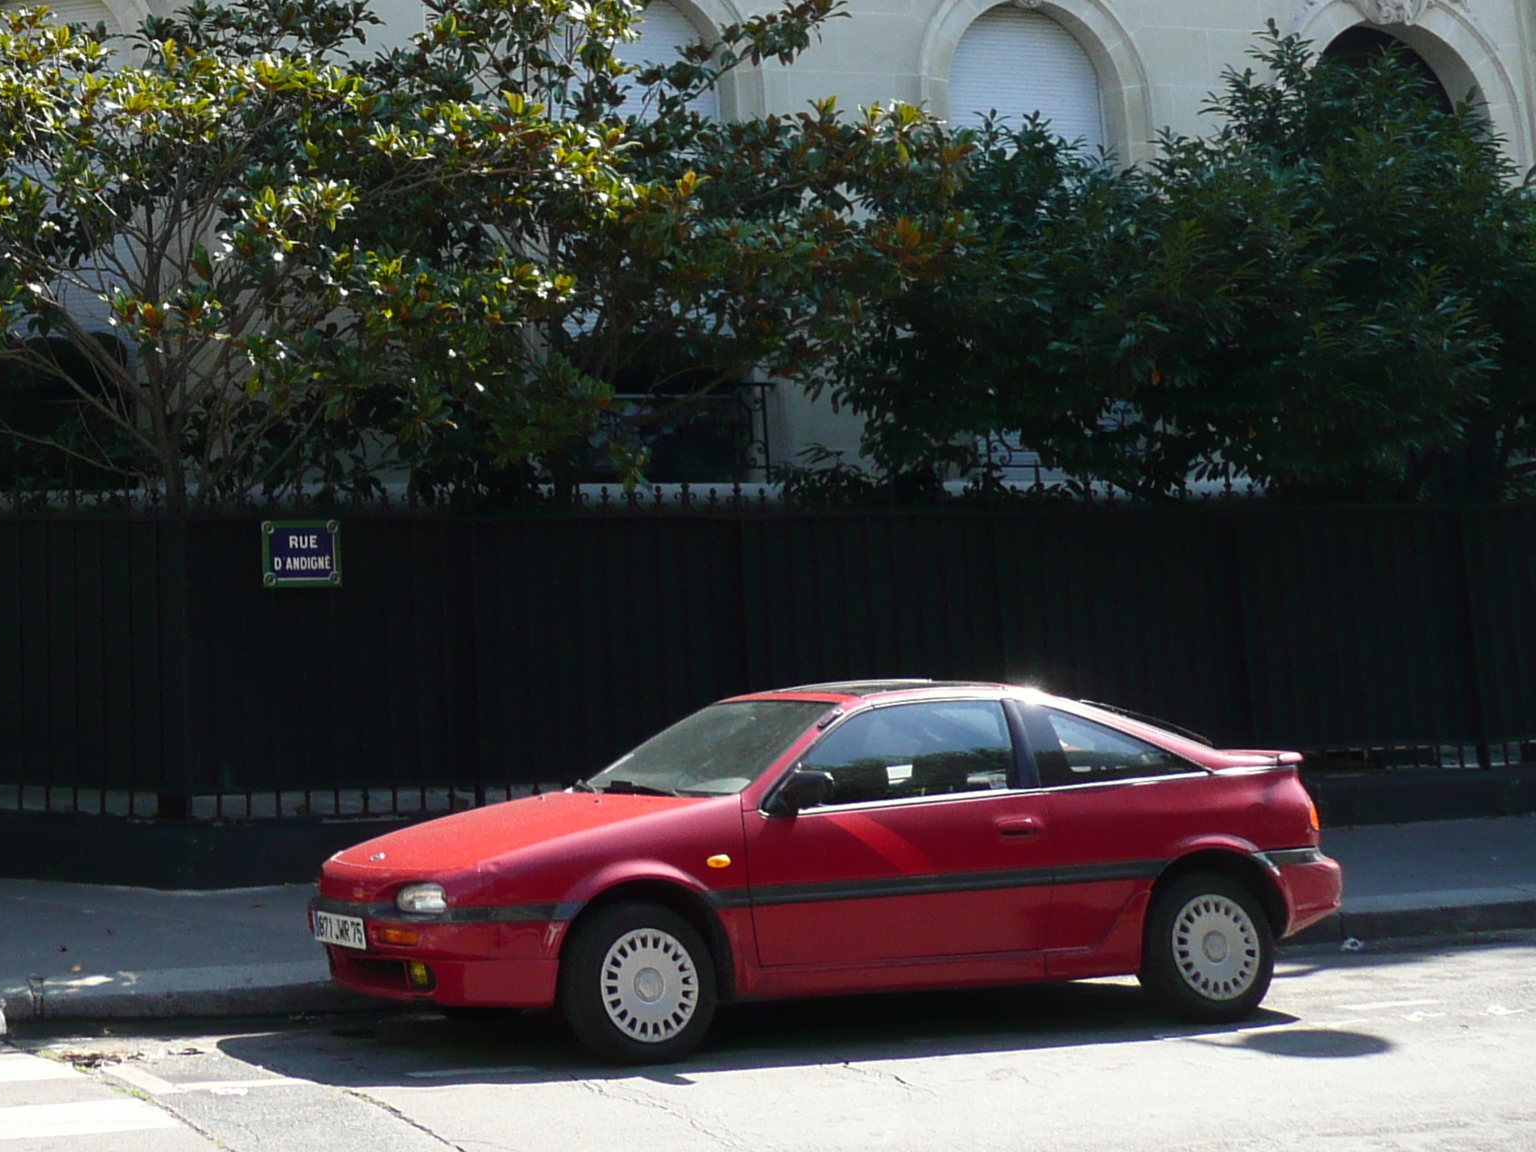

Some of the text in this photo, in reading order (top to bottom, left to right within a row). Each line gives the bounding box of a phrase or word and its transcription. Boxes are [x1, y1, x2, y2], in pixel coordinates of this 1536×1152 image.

[288, 535, 318, 549] RUE
[319, 914, 333, 938] 871
[350, 920, 363, 945] 75
